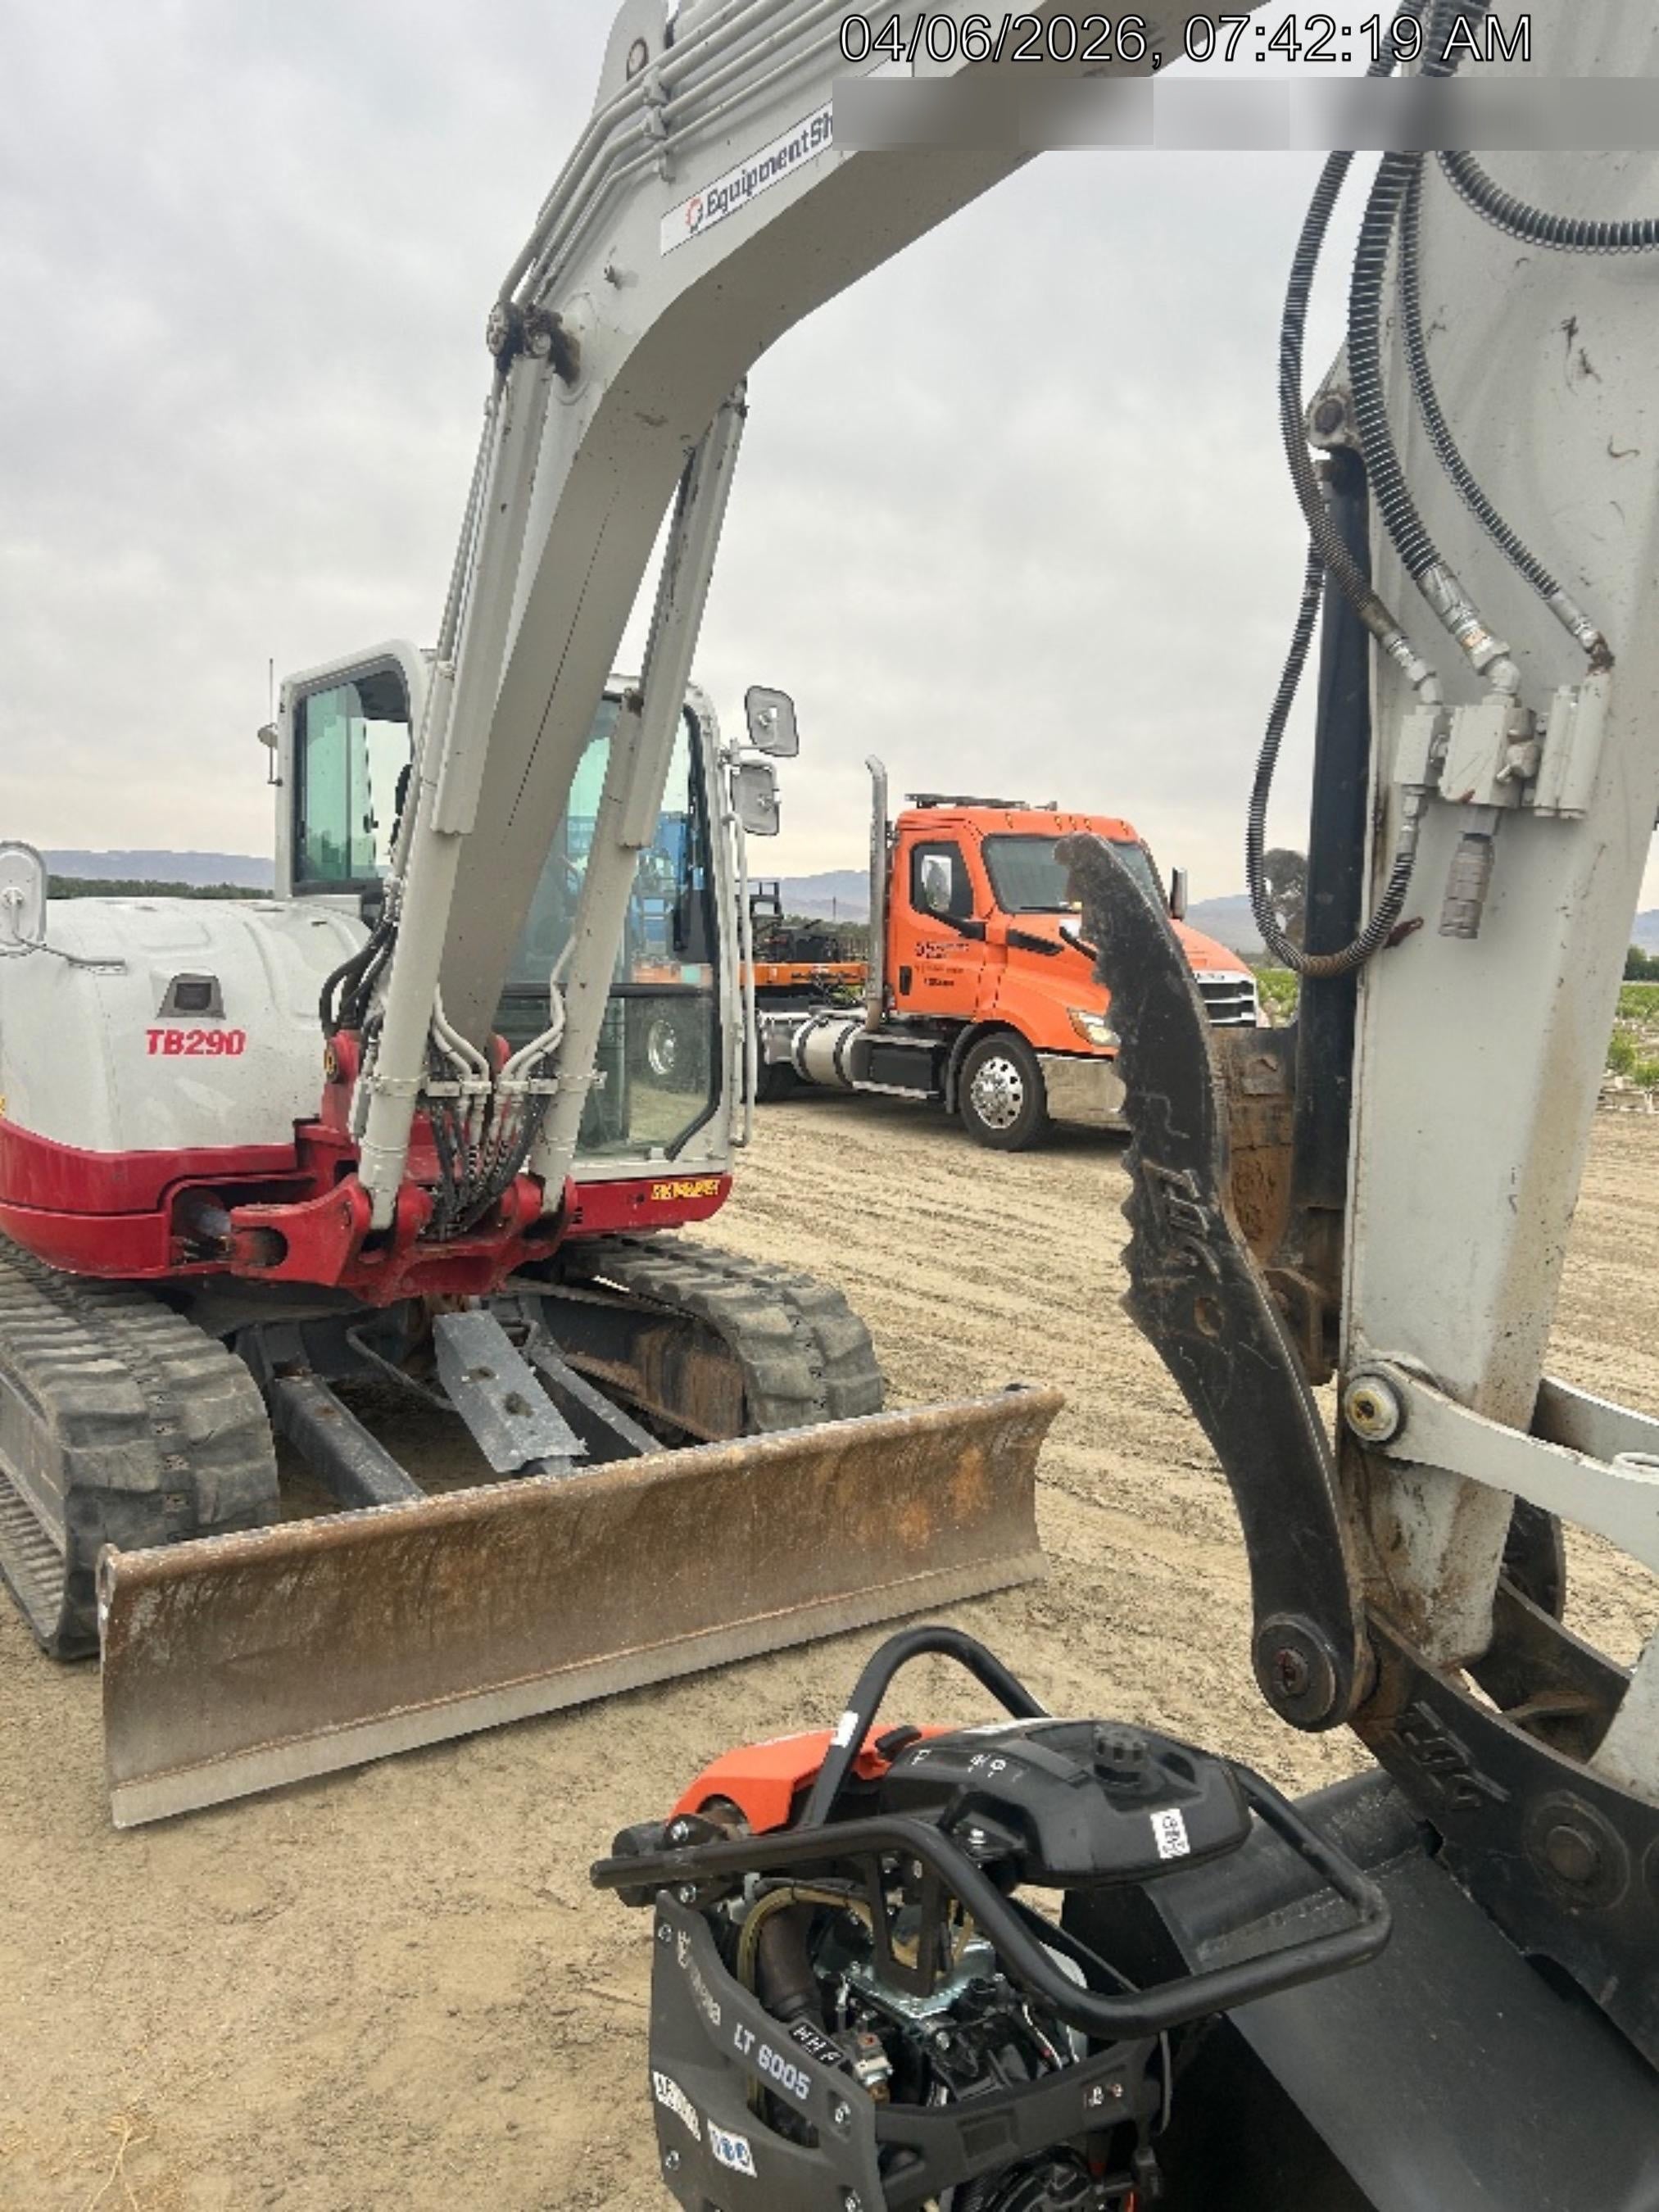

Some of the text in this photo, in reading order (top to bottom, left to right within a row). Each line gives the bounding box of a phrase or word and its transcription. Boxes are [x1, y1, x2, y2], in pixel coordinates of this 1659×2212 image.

[146, 1029, 247, 1055] TB290
[734, 2022, 812, 2101] LT 6005
